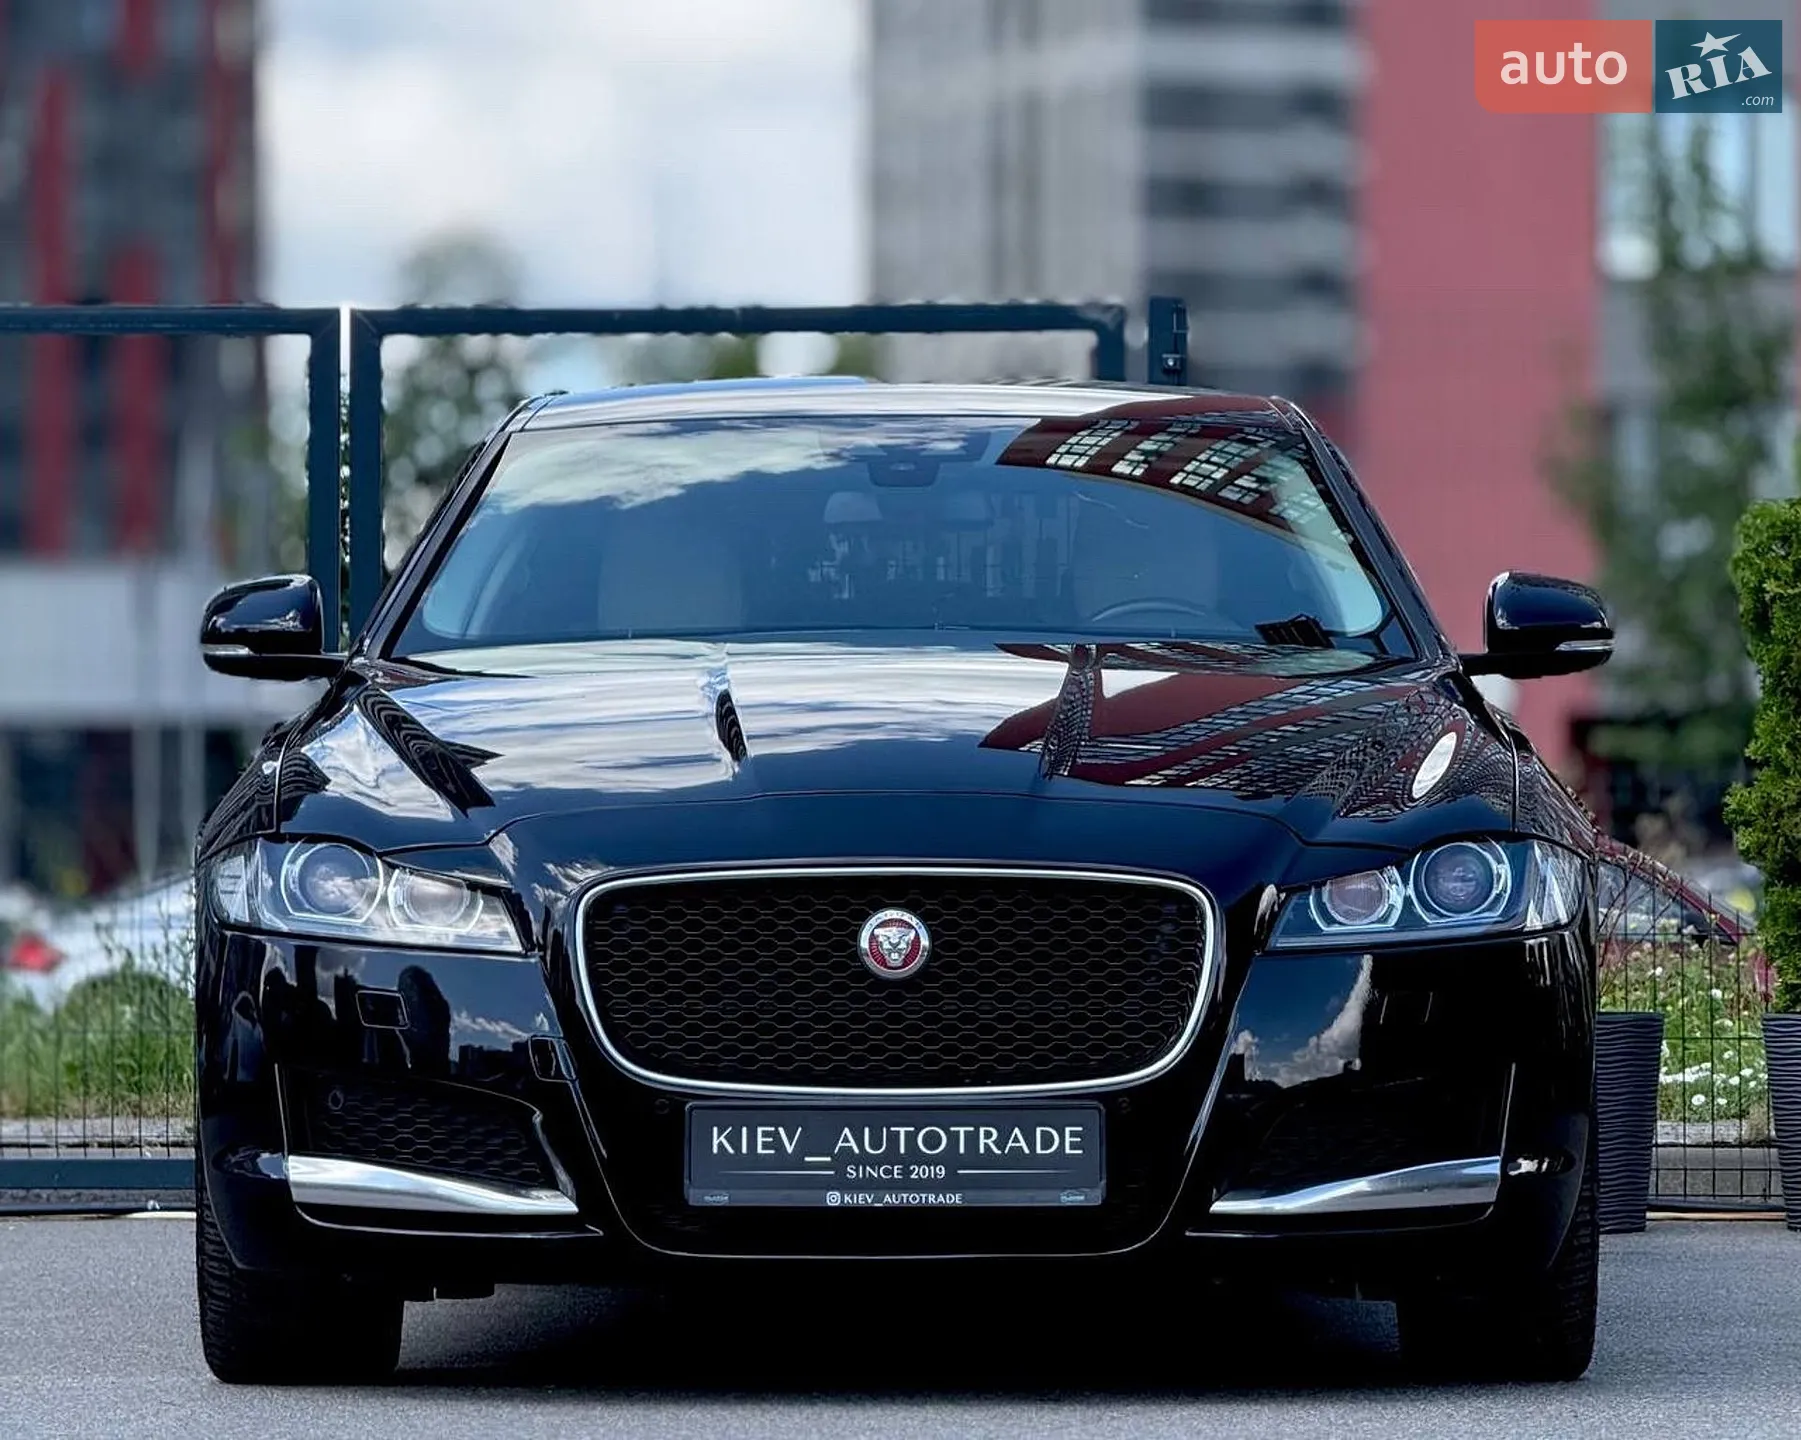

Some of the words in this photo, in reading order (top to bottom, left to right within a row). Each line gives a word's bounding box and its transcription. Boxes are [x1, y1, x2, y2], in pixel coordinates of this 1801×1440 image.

[711, 1126, 1084, 1162] KIEV_AUTOTRADE
[846, 1164, 903, 1179] SINCE
[909, 1164, 946, 1179] 2019
[843, 1191, 963, 1207] KIEV_AUTOTRADE
